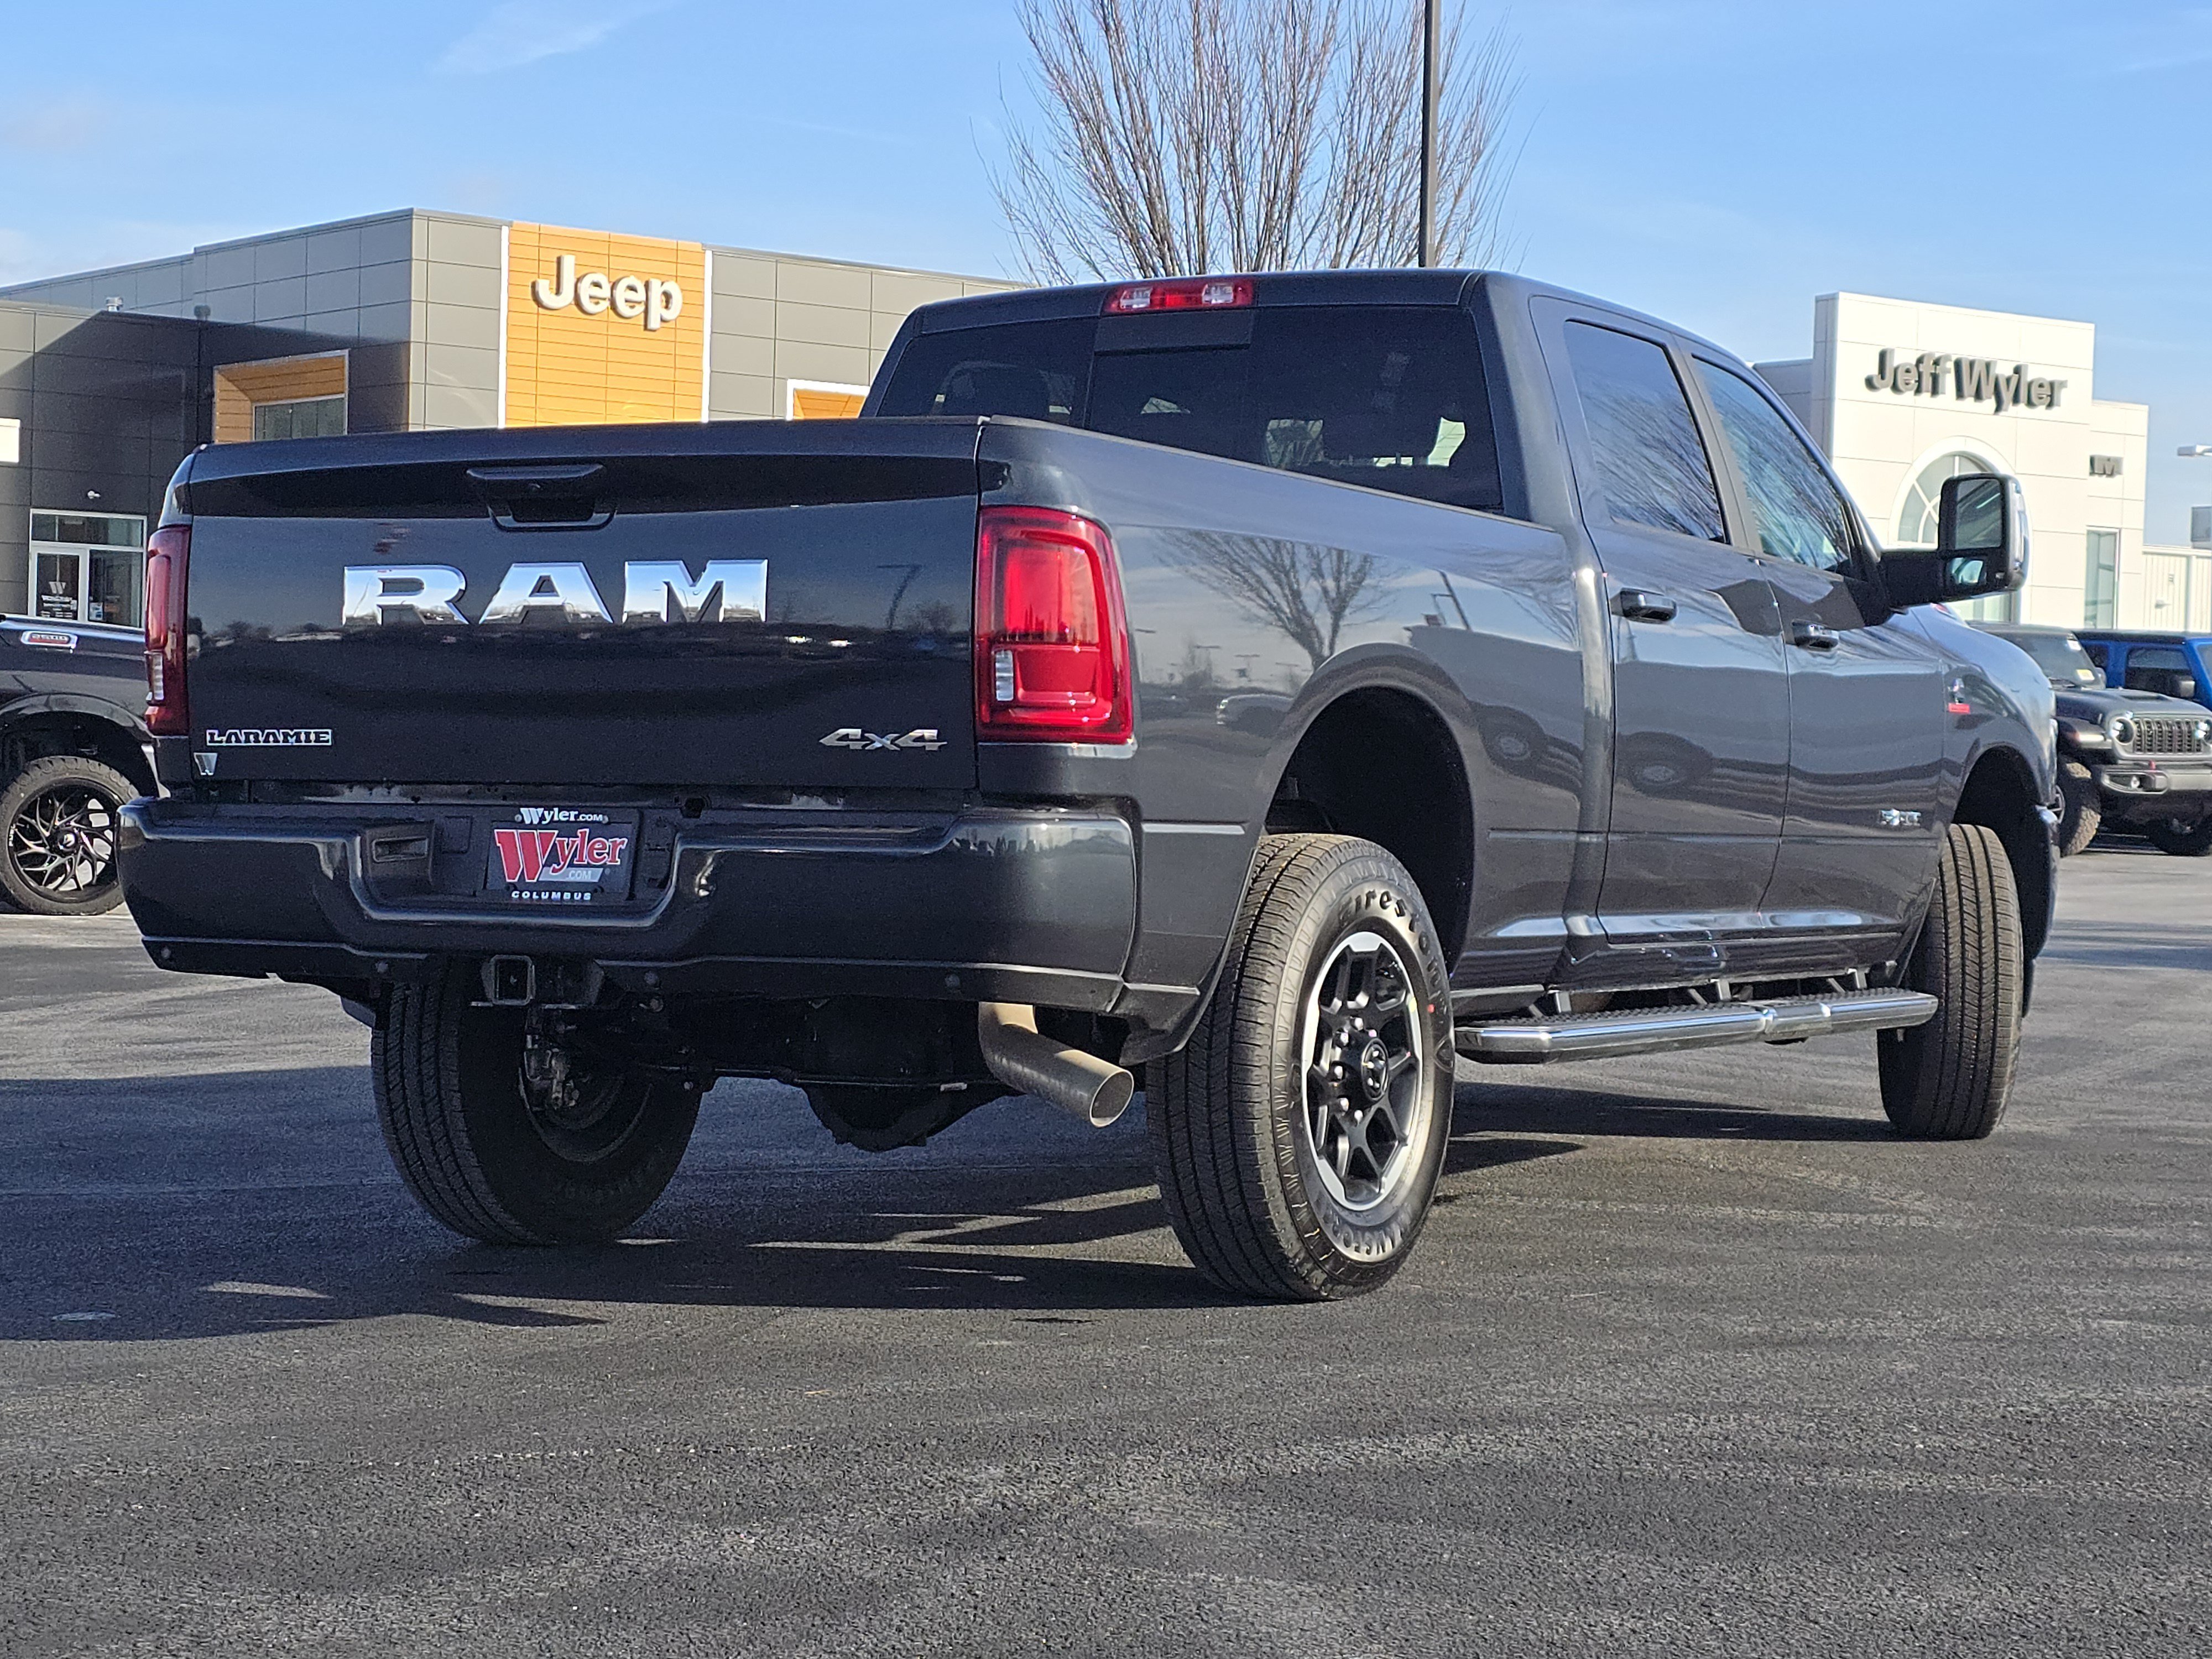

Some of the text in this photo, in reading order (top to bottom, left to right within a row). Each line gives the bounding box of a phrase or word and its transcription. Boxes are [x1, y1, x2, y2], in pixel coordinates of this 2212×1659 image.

[531, 254, 683, 332] Jeep
[1864, 347, 2068, 415] Jeff Wyler
[342, 560, 769, 625] RAM
[206, 729, 332, 746] LARAMIE
[818, 728, 948, 751] 4x4
[494, 828, 628, 883] Wyler
[511, 890, 592, 901] COLUMBUS
